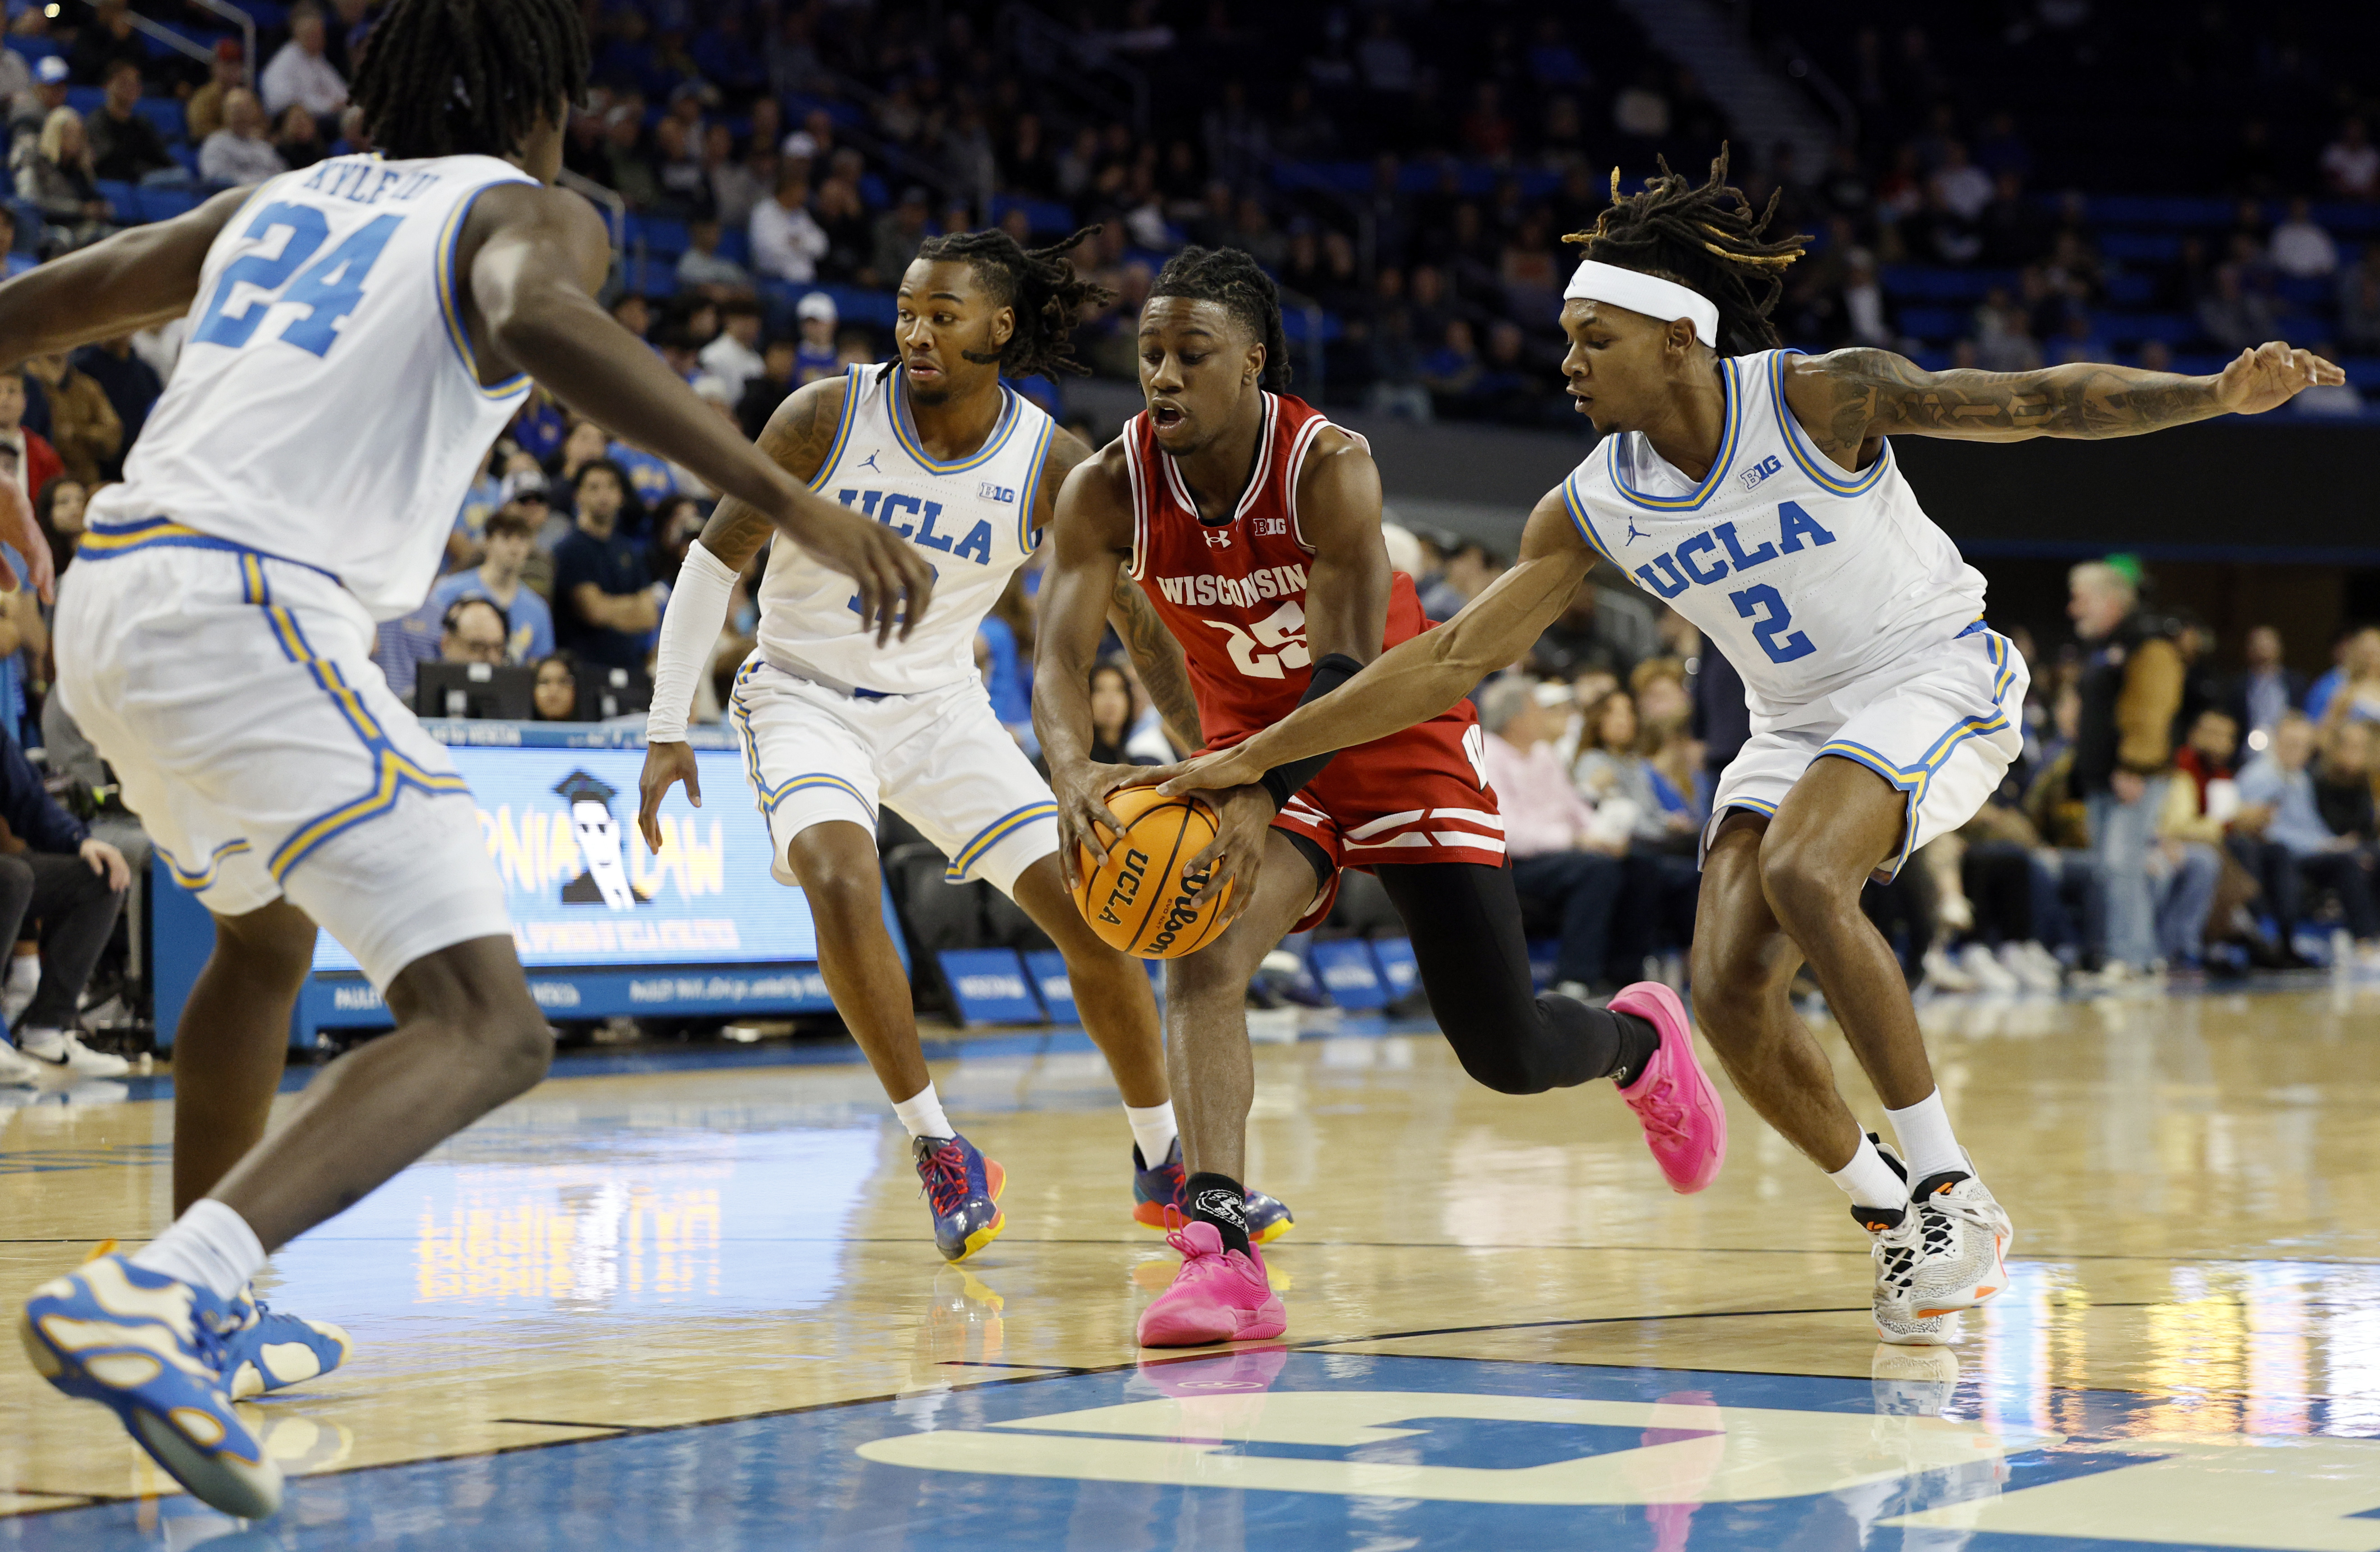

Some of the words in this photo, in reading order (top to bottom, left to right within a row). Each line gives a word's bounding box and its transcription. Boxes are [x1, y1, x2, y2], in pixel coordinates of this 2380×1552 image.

[188, 199, 408, 358] 24
[1157, 563, 1307, 608] WISCONSIN
[1635, 501, 1836, 599] UCLA
[1202, 600, 1312, 679] 25
[1728, 583, 1817, 663] 2
[1098, 848, 1149, 926] UCLA
